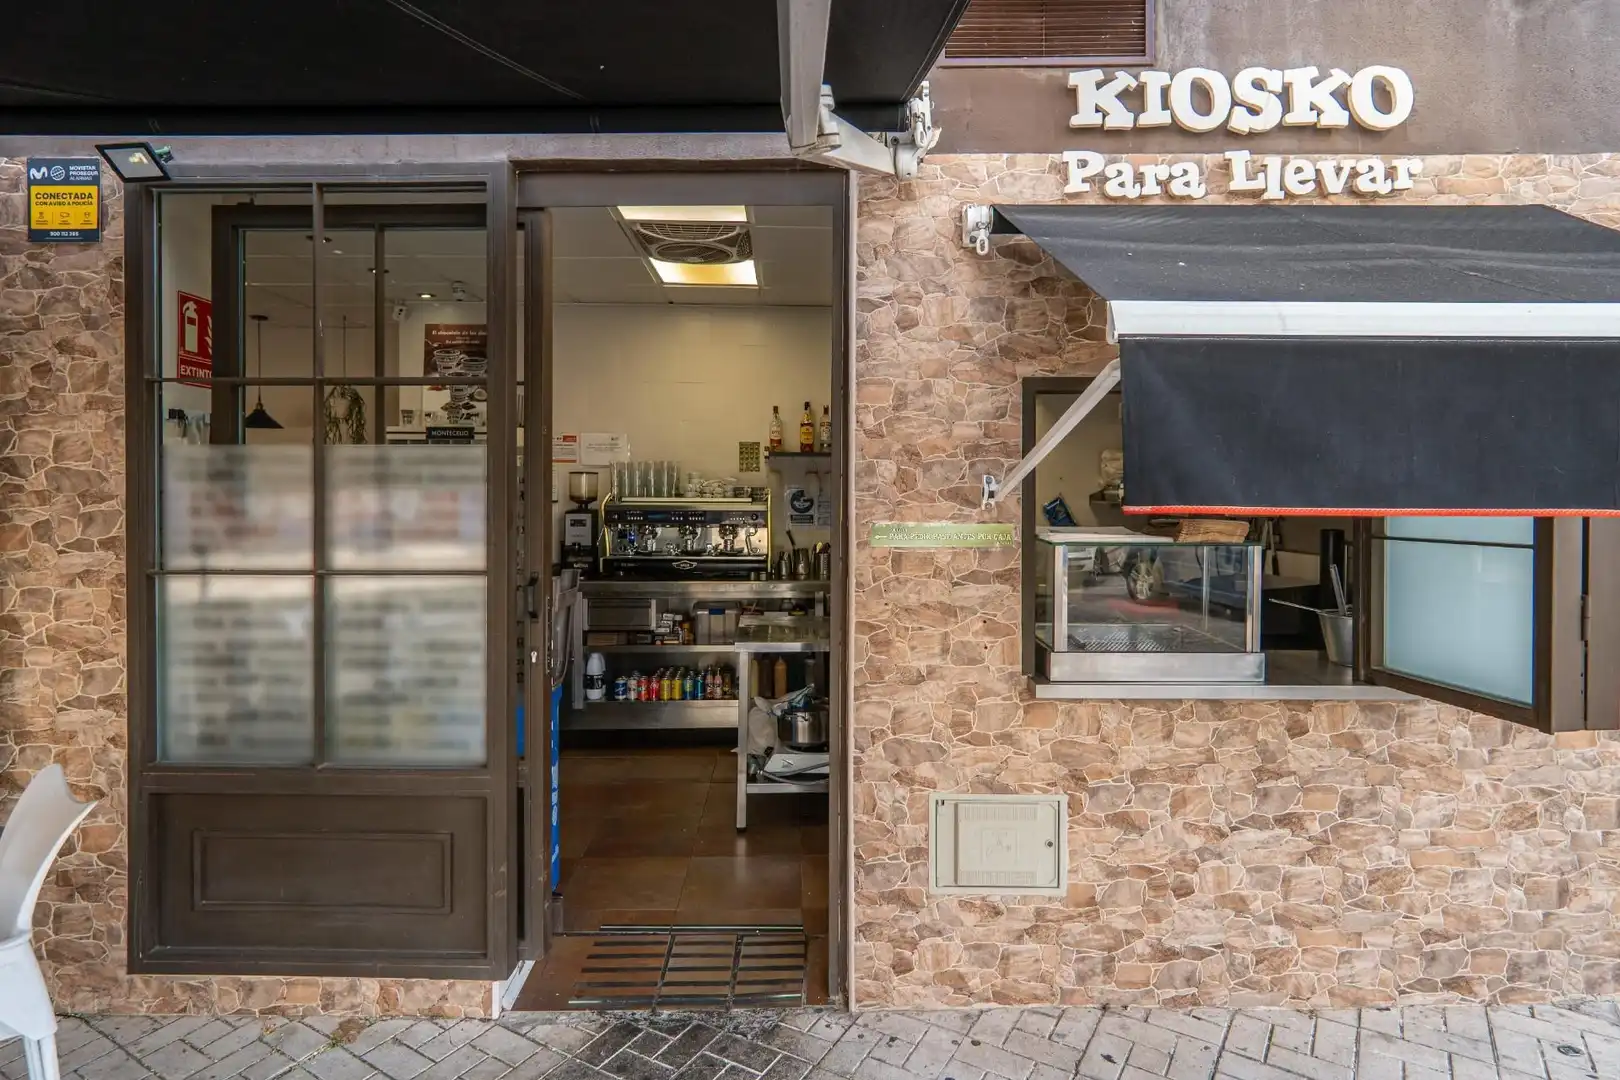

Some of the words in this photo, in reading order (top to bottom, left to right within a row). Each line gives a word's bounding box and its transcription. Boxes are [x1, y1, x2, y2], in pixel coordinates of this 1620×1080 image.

[1067, 65, 1414, 135] KIOSKO
[1062, 150, 1206, 199] Para
[1224, 149, 1423, 200] Llevar
[180, 364, 212, 378] EXTINT
